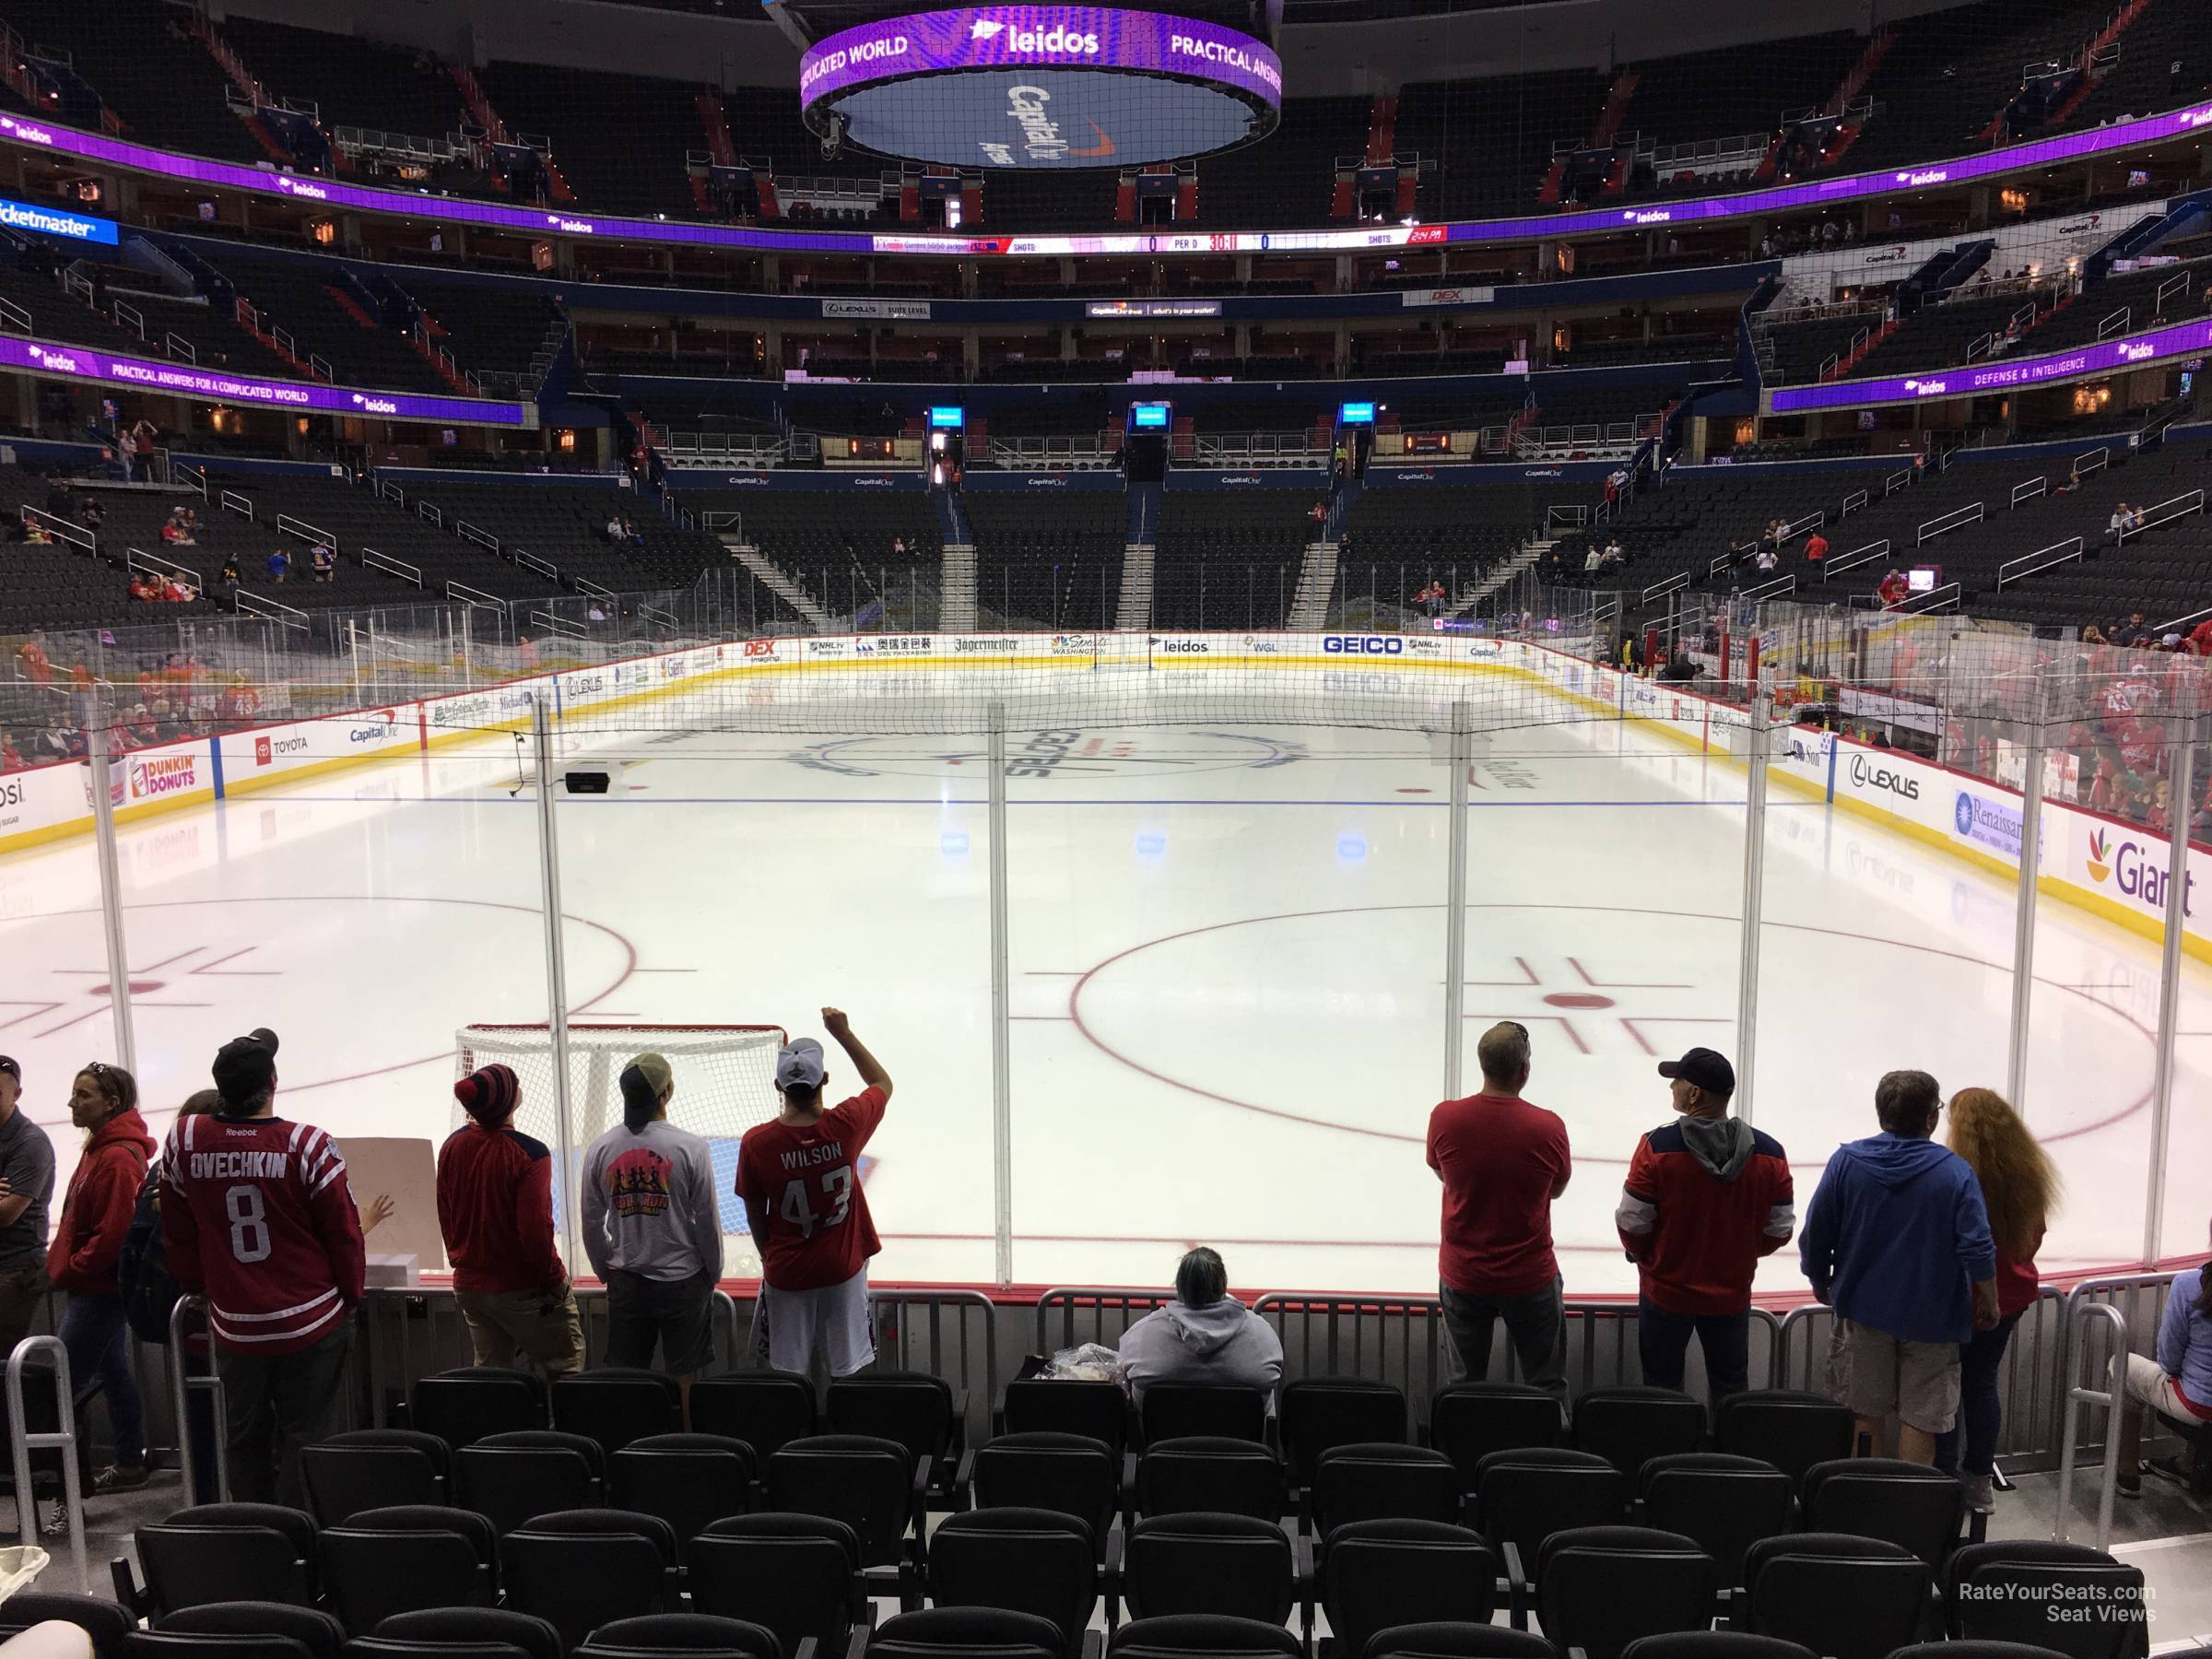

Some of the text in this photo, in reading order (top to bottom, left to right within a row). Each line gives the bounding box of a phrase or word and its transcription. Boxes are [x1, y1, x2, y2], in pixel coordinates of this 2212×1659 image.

[1009, 25, 1099, 53] leidos
[849, 37, 908, 64] WORLD
[1171, 34, 1252, 72] PRACTICAL
[15, 124, 53, 145] leidos
[1912, 169, 1947, 185] leidos
[292, 182, 326, 199] leidos
[1637, 209, 1670, 223] leidos
[561, 219, 593, 233] leidos
[1149, 236, 1157, 252] 0
[1174, 239, 1189, 249] PER
[1261, 234, 1269, 251] 0
[1431, 290, 1461, 300] DEX
[2127, 341, 2154, 360] leidos
[43, 352, 76, 371] leidos
[1974, 357, 2086, 385] DEFENSE & INTELLIGENCE
[112, 364, 309, 403] PRACTICAL ANSWERS FOR A COMPLICATED WORLD
[1918, 380, 1946, 395] leidos
[365, 397, 396, 414] leidos
[744, 641, 776, 656] DEX
[1164, 640, 1208, 653] leidos
[1253, 643, 1278, 653] WGL
[1324, 637, 1402, 653] GEICO
[578, 676, 603, 694] LEXUS
[274, 737, 308, 754] TOYOTA
[1806, 745, 1819, 768] Son
[148, 754, 195, 778] DUNKIN'
[149, 771, 195, 794] DONUTS
[1867, 765, 1919, 800] LEXUS
[3, 816, 18, 827] SUGAR
[226, 1128, 257, 1136] Reebok
[191, 1151, 288, 1179] OVECHKIN
[781, 1141, 842, 1171] WILSON
[780, 1164, 853, 1239] 43
[226, 1184, 272, 1264] 8
